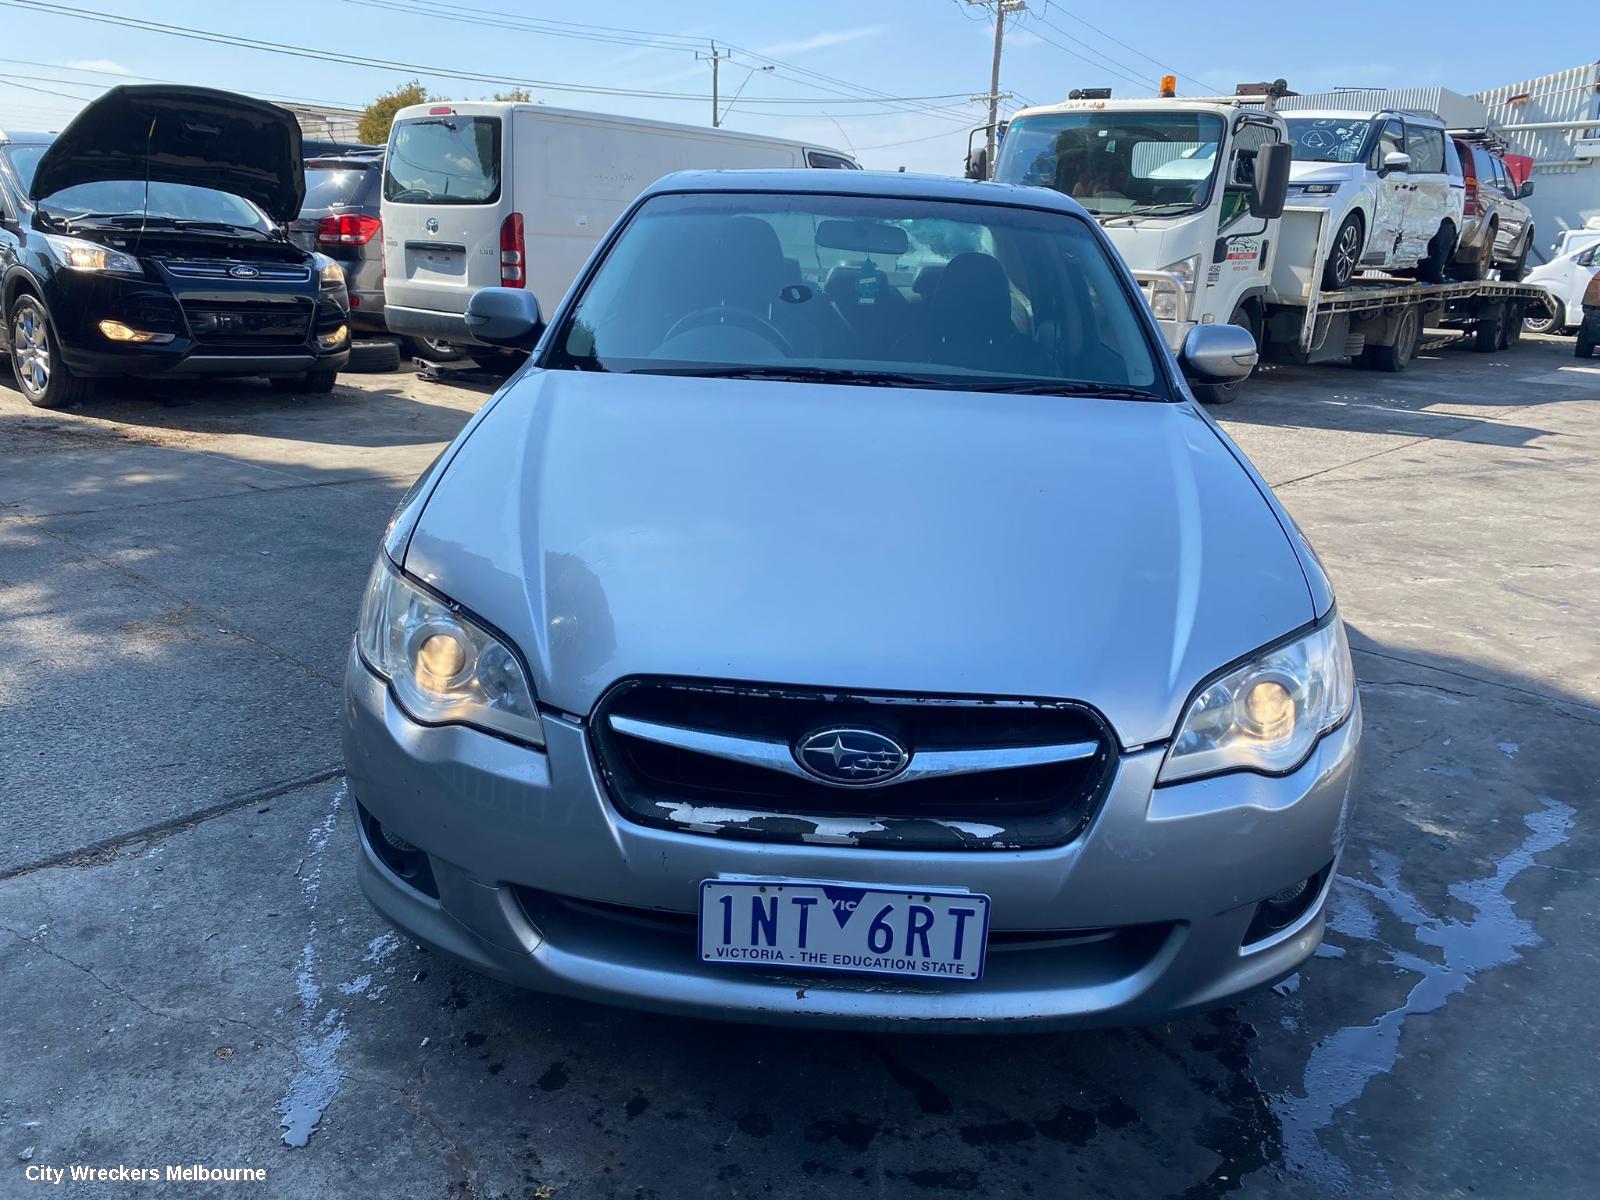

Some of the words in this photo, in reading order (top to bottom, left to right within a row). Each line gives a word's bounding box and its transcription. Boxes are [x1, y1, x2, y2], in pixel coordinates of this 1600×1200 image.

[828, 899, 857, 911] VIC
[719, 895, 818, 949] 1NT
[867, 904, 976, 961] 6RT
[716, 947, 784, 960] VICTORIA
[800, 951, 827, 963] THE
[832, 954, 916, 970] EDUCATION
[921, 961, 964, 974] STATE
